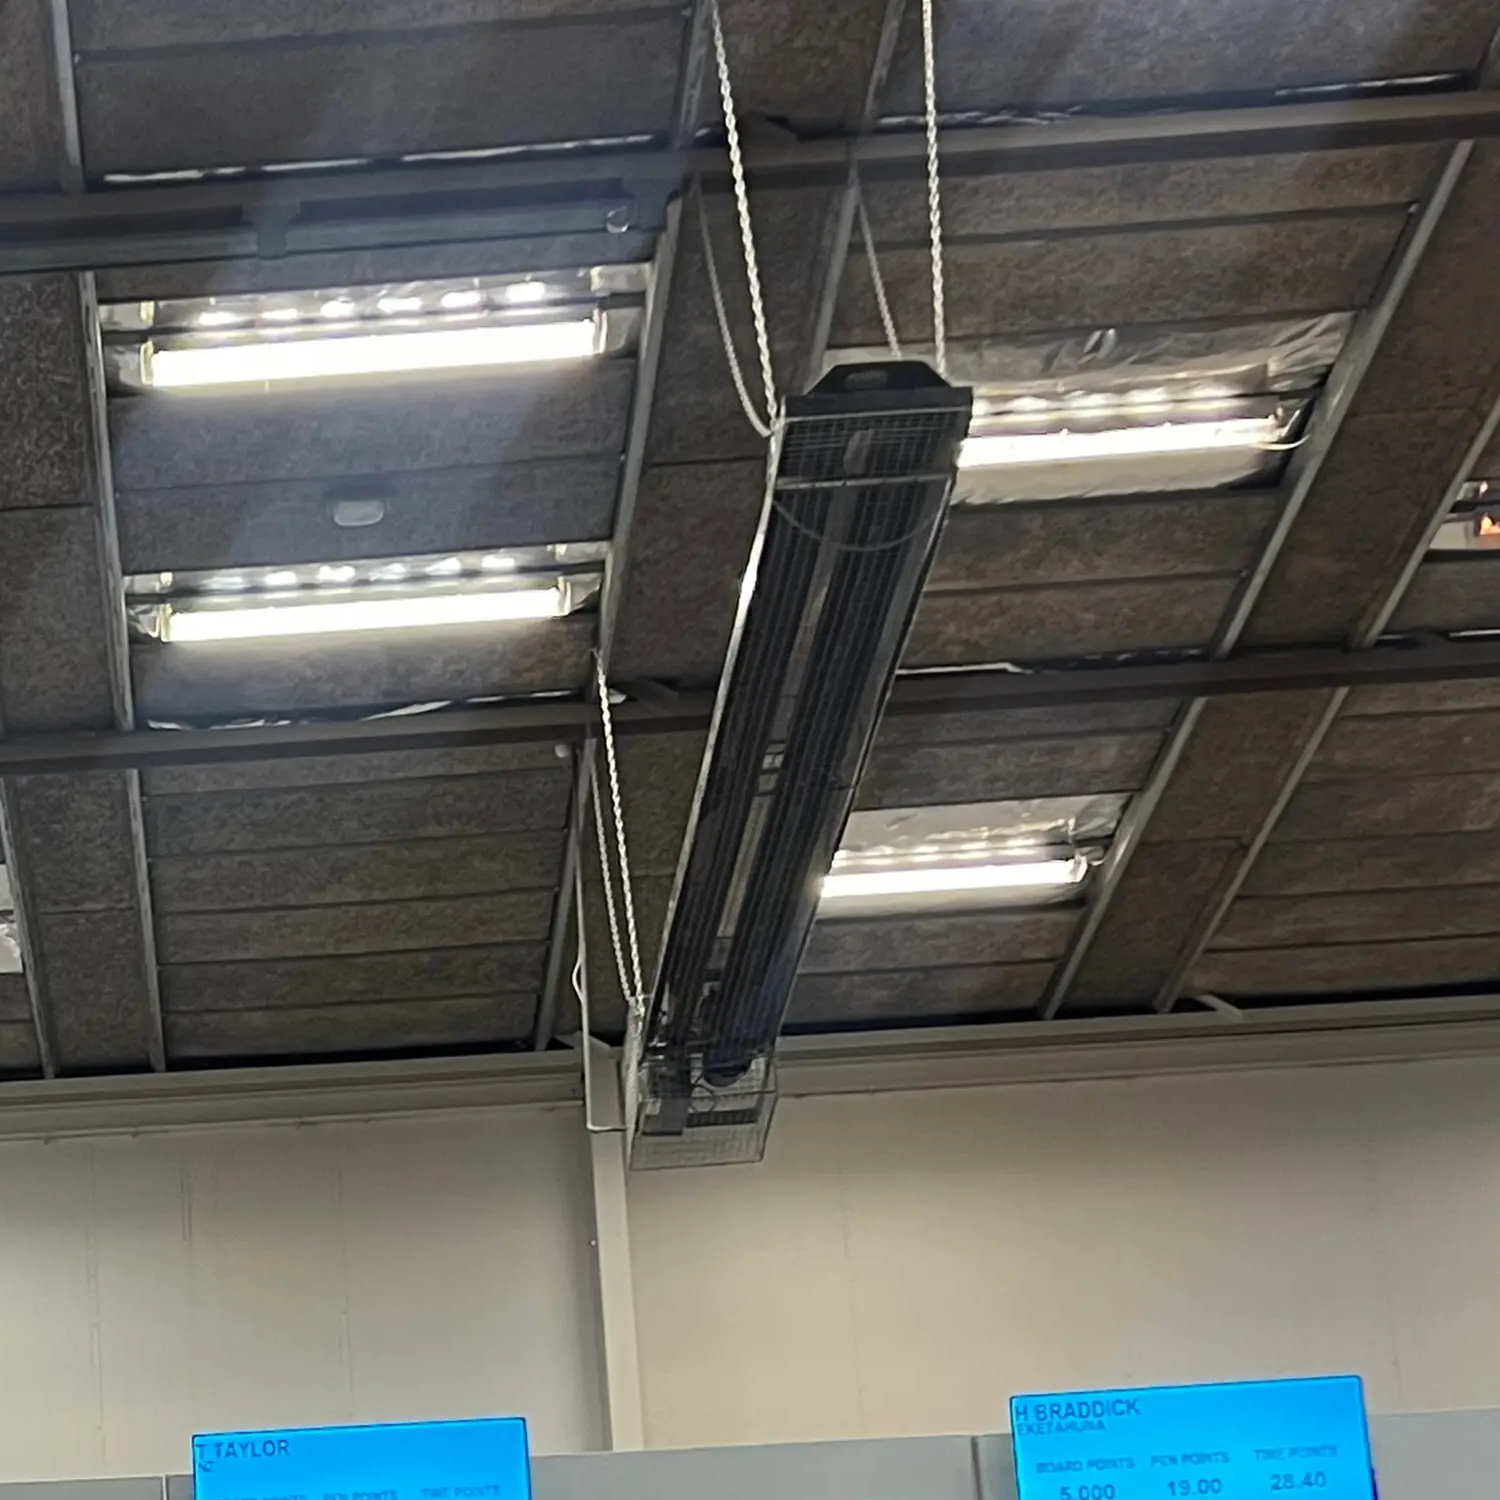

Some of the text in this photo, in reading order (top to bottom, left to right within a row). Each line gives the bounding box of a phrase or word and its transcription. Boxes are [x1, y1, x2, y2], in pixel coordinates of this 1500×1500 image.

[1016, 1399, 1141, 1421] H BRADDICK
[212, 1439, 290, 1459] TAYLOR
[1167, 1478, 1222, 1497] 19.00
[1271, 1471, 1327, 1491] 28.40
